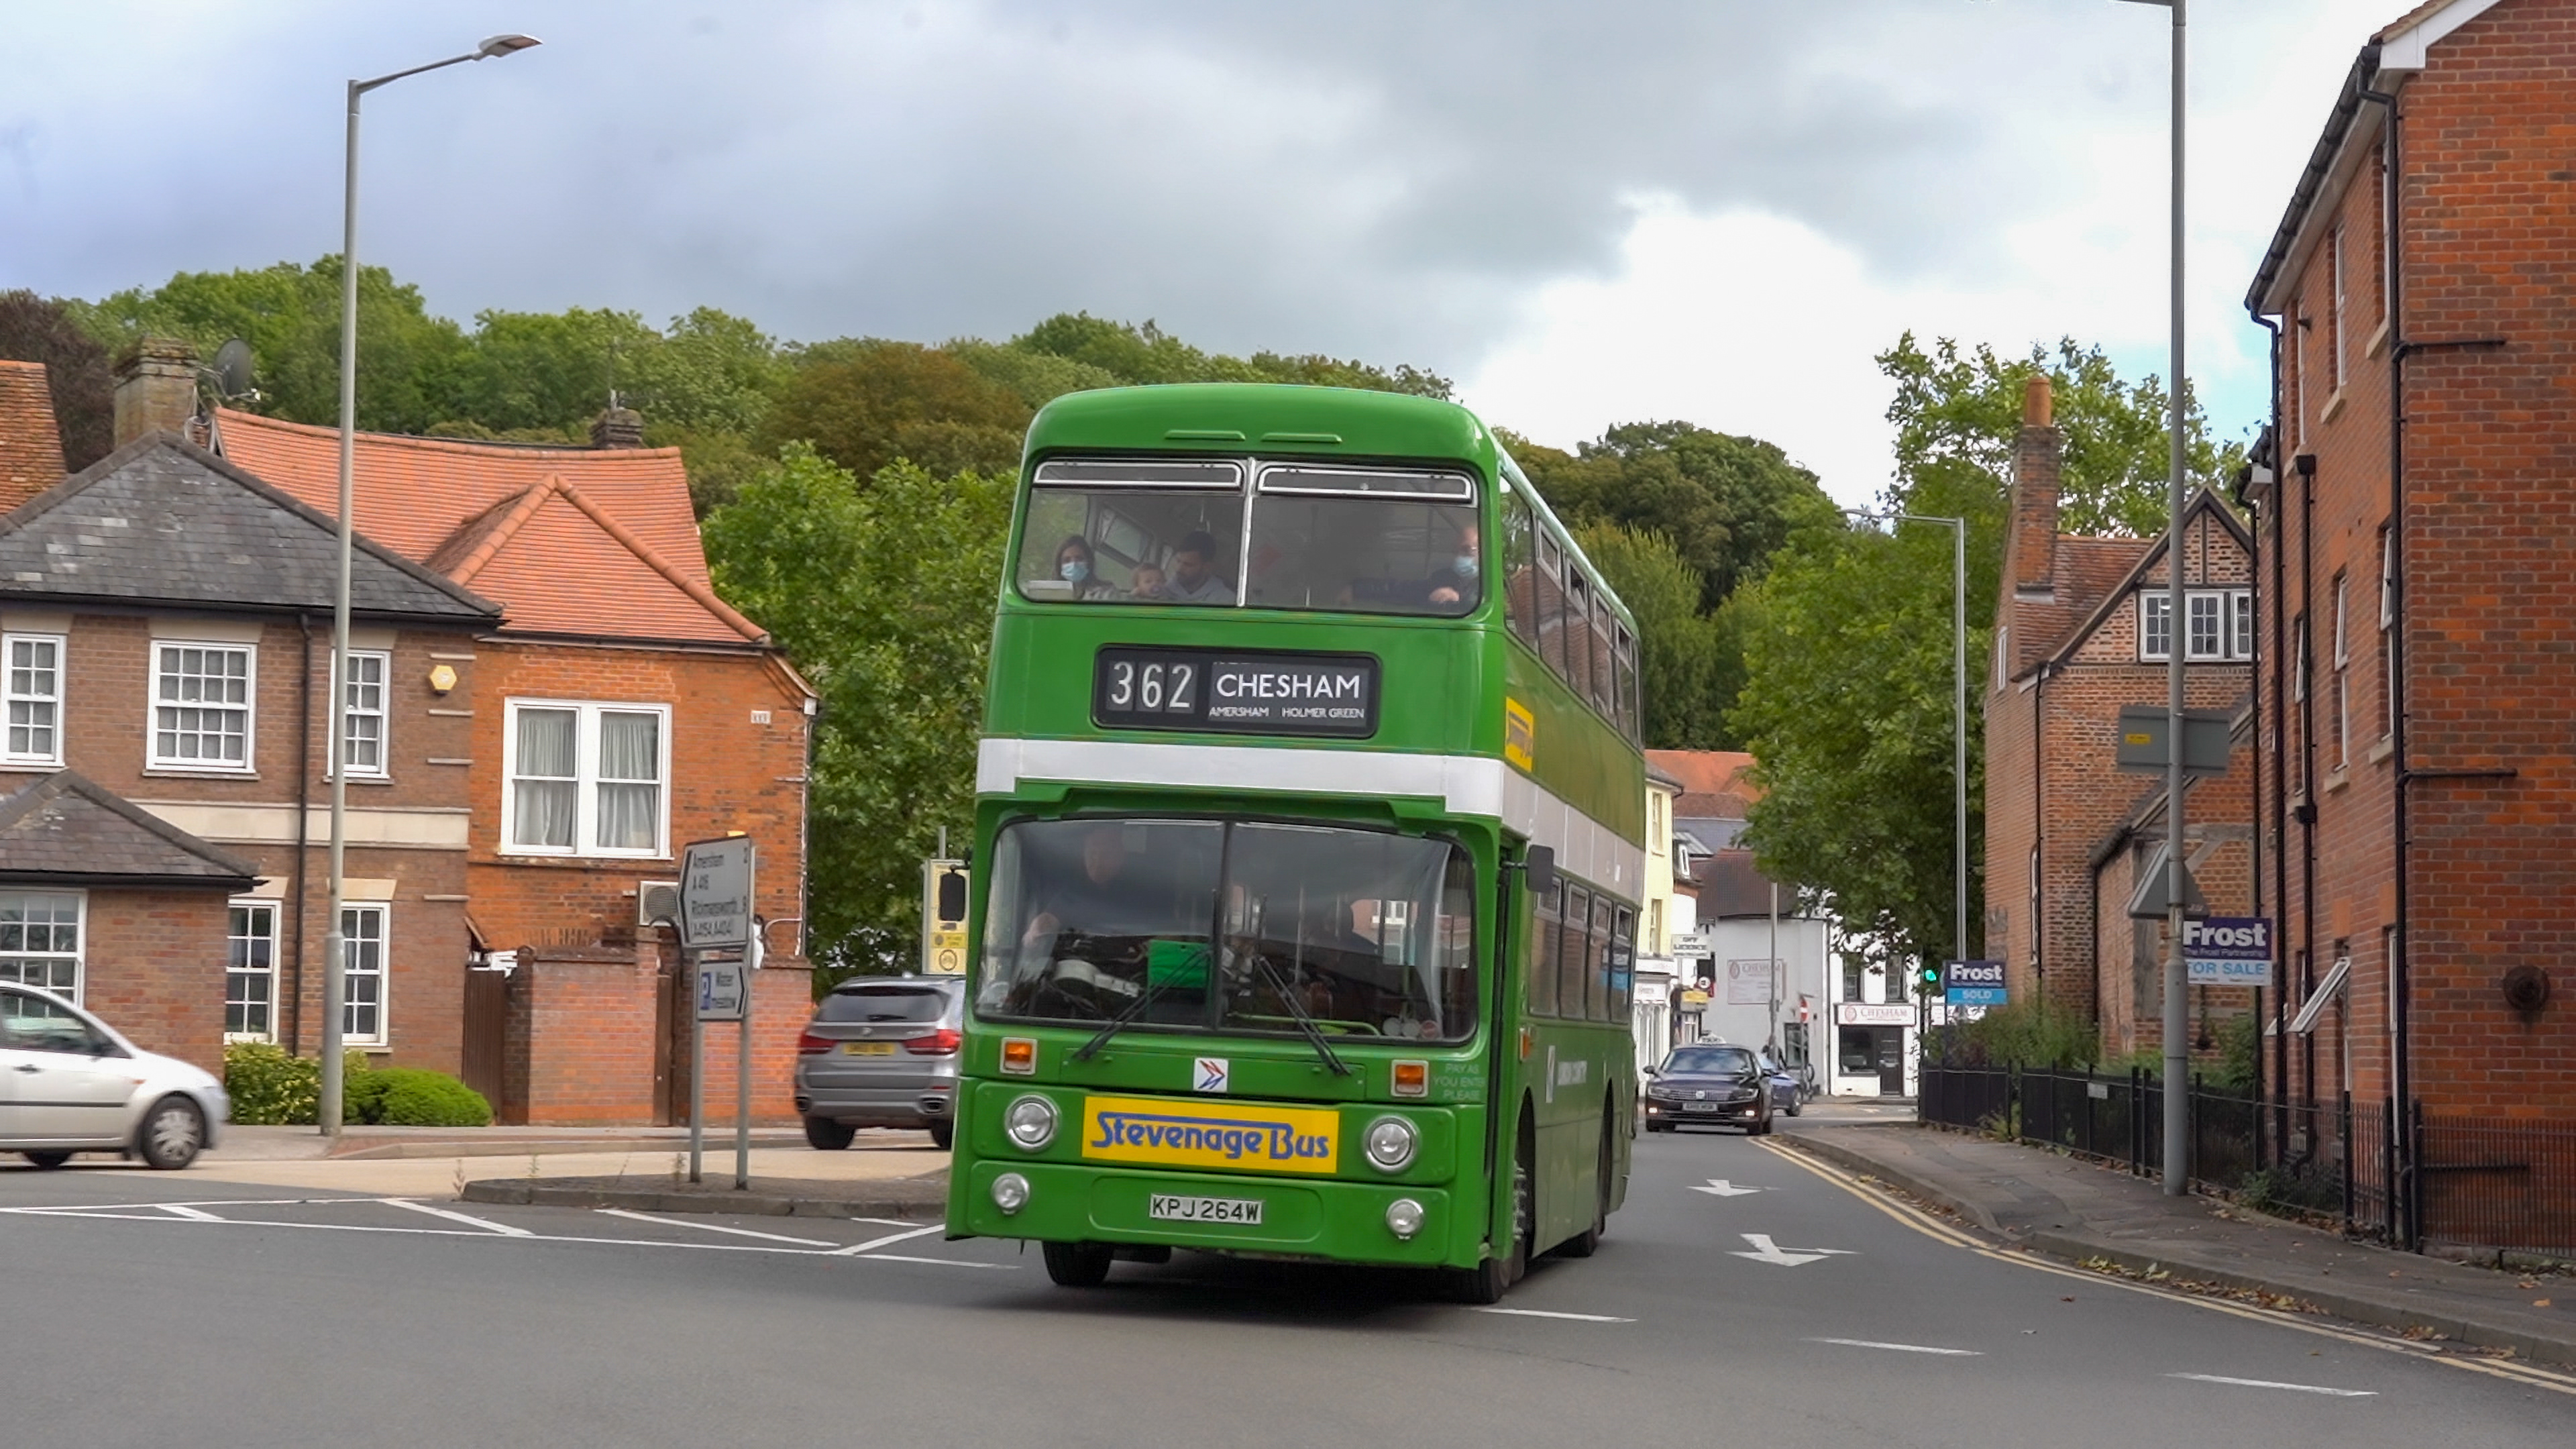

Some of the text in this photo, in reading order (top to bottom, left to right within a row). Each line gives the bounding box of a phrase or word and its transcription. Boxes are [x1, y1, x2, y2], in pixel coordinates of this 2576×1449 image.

[1111, 661, 1192, 708] 362
[1216, 674, 1360, 699] CHESHAM
[1209, 706, 1364, 719] AMERSHAM HOLMER GREEN
[2183, 921, 2266, 947] Frost
[1950, 963, 2002, 980] Frost
[2222, 962, 2265, 975] SALE
[1963, 989, 1992, 1000] SOLD
[1091, 1111, 1330, 1159] Stevenage Bus
